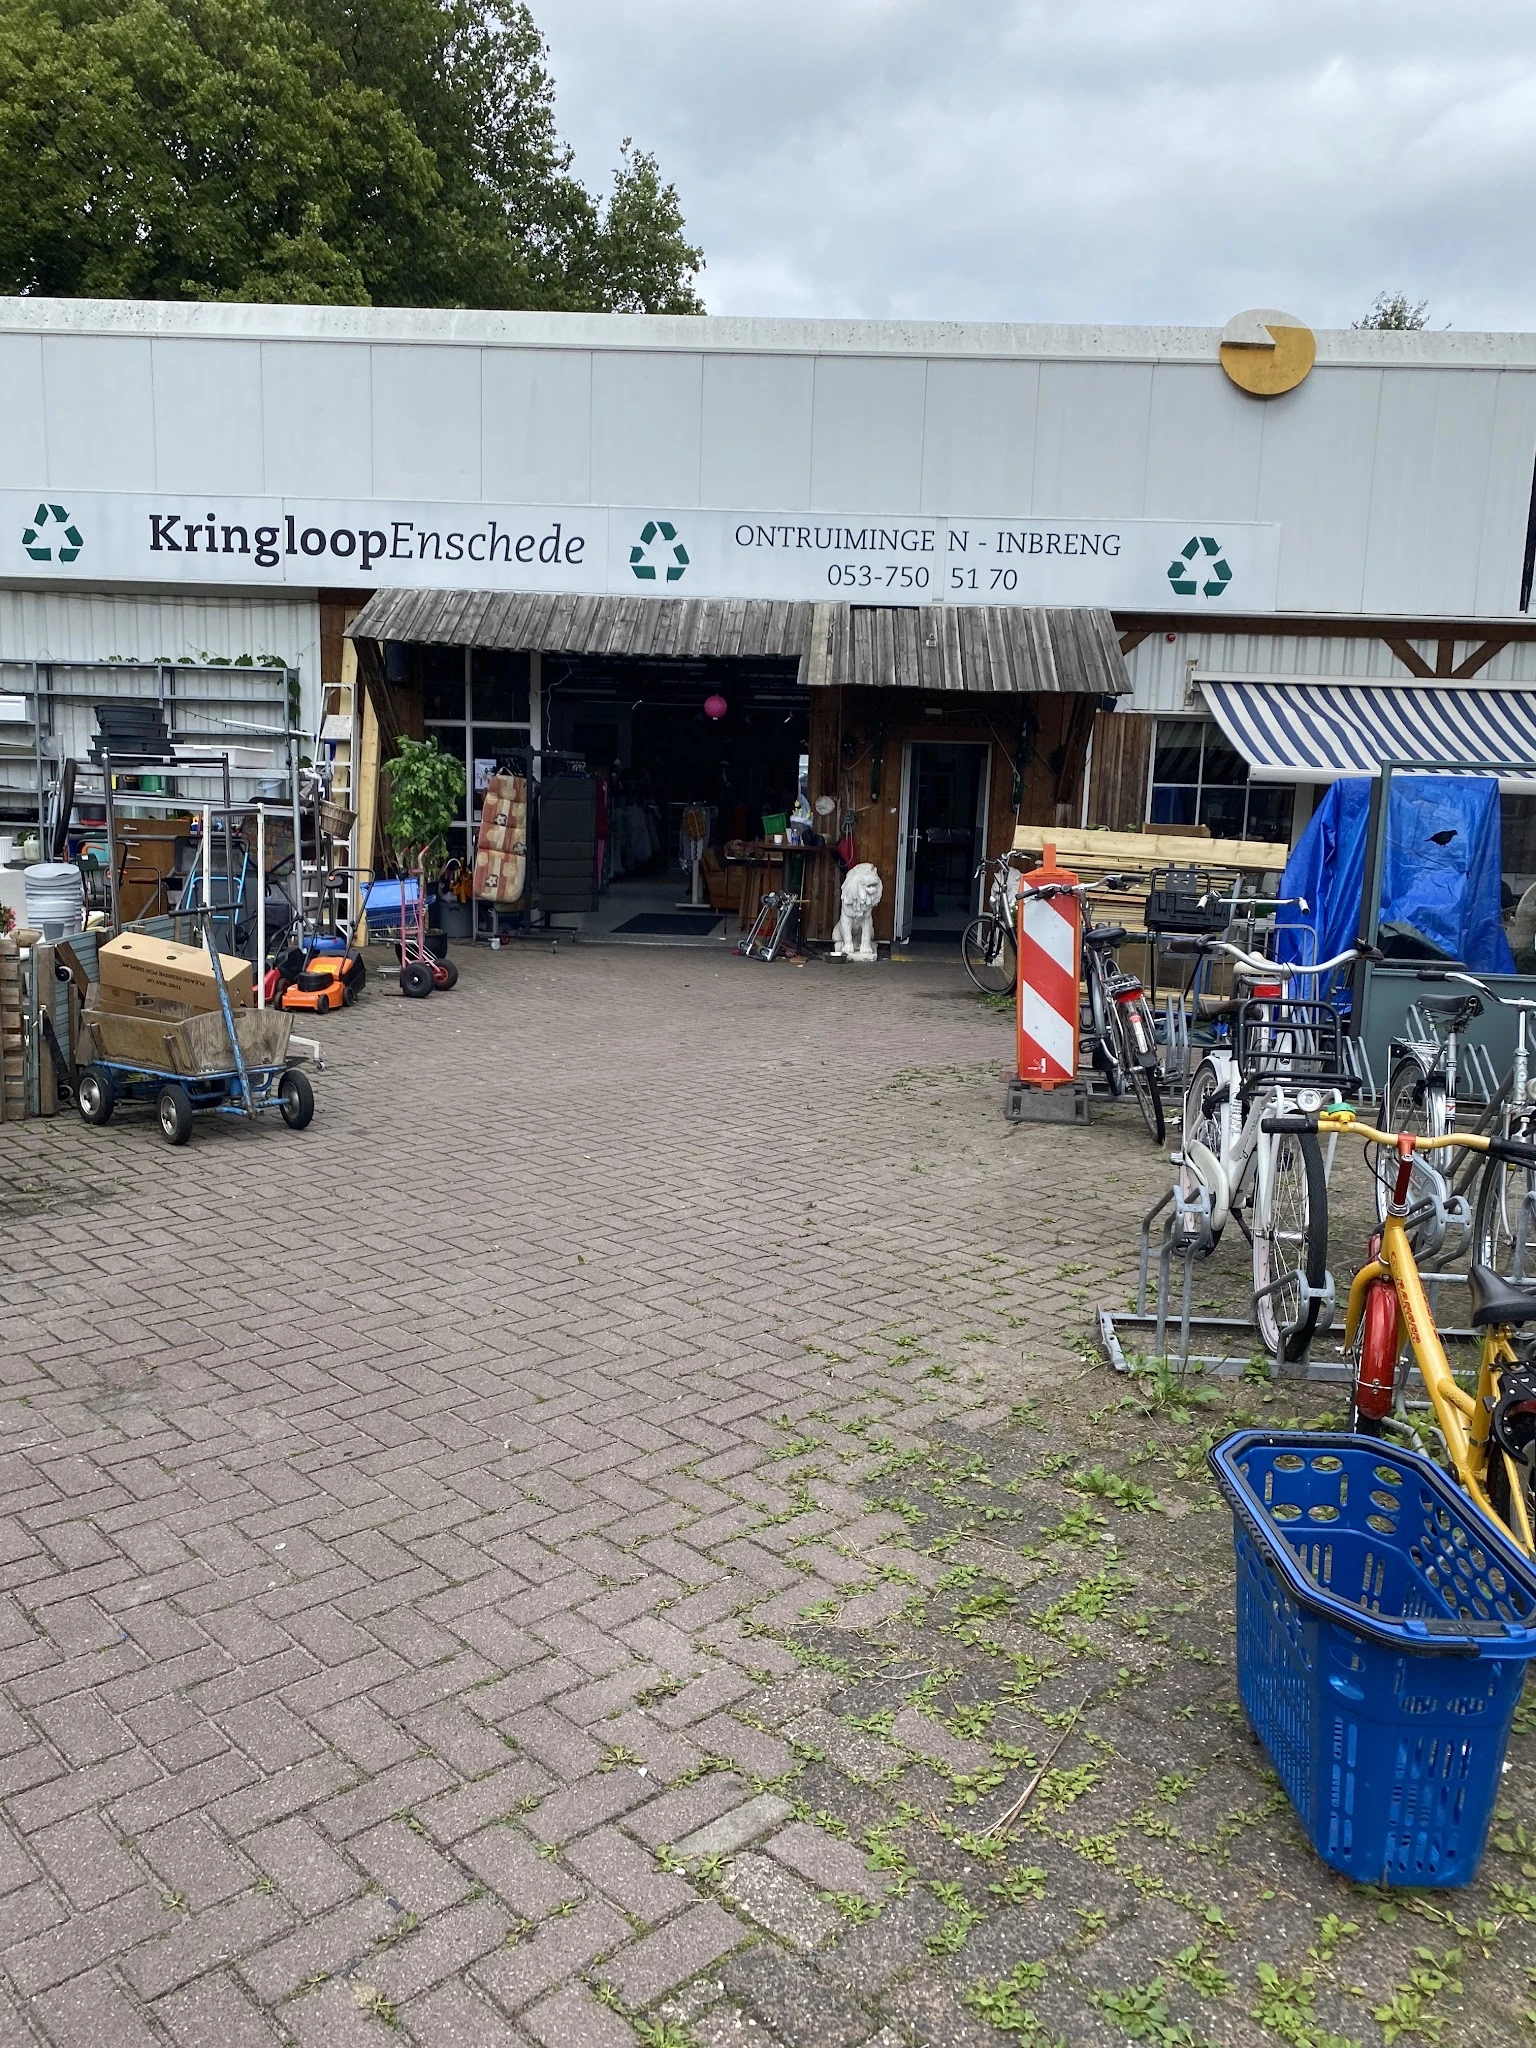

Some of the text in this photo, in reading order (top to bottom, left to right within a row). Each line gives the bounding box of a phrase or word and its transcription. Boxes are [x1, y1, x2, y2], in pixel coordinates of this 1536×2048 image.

[148, 513, 586, 570] KringloopEnschede
[996, 531, 1123, 557] INBRENG
[827, 563, 1019, 592] 053-750 51 70
[122, 963, 145, 972] DISPLAY
[158, 971, 182, 981] REMOVE
[183, 978, 206, 987] PLEASE
